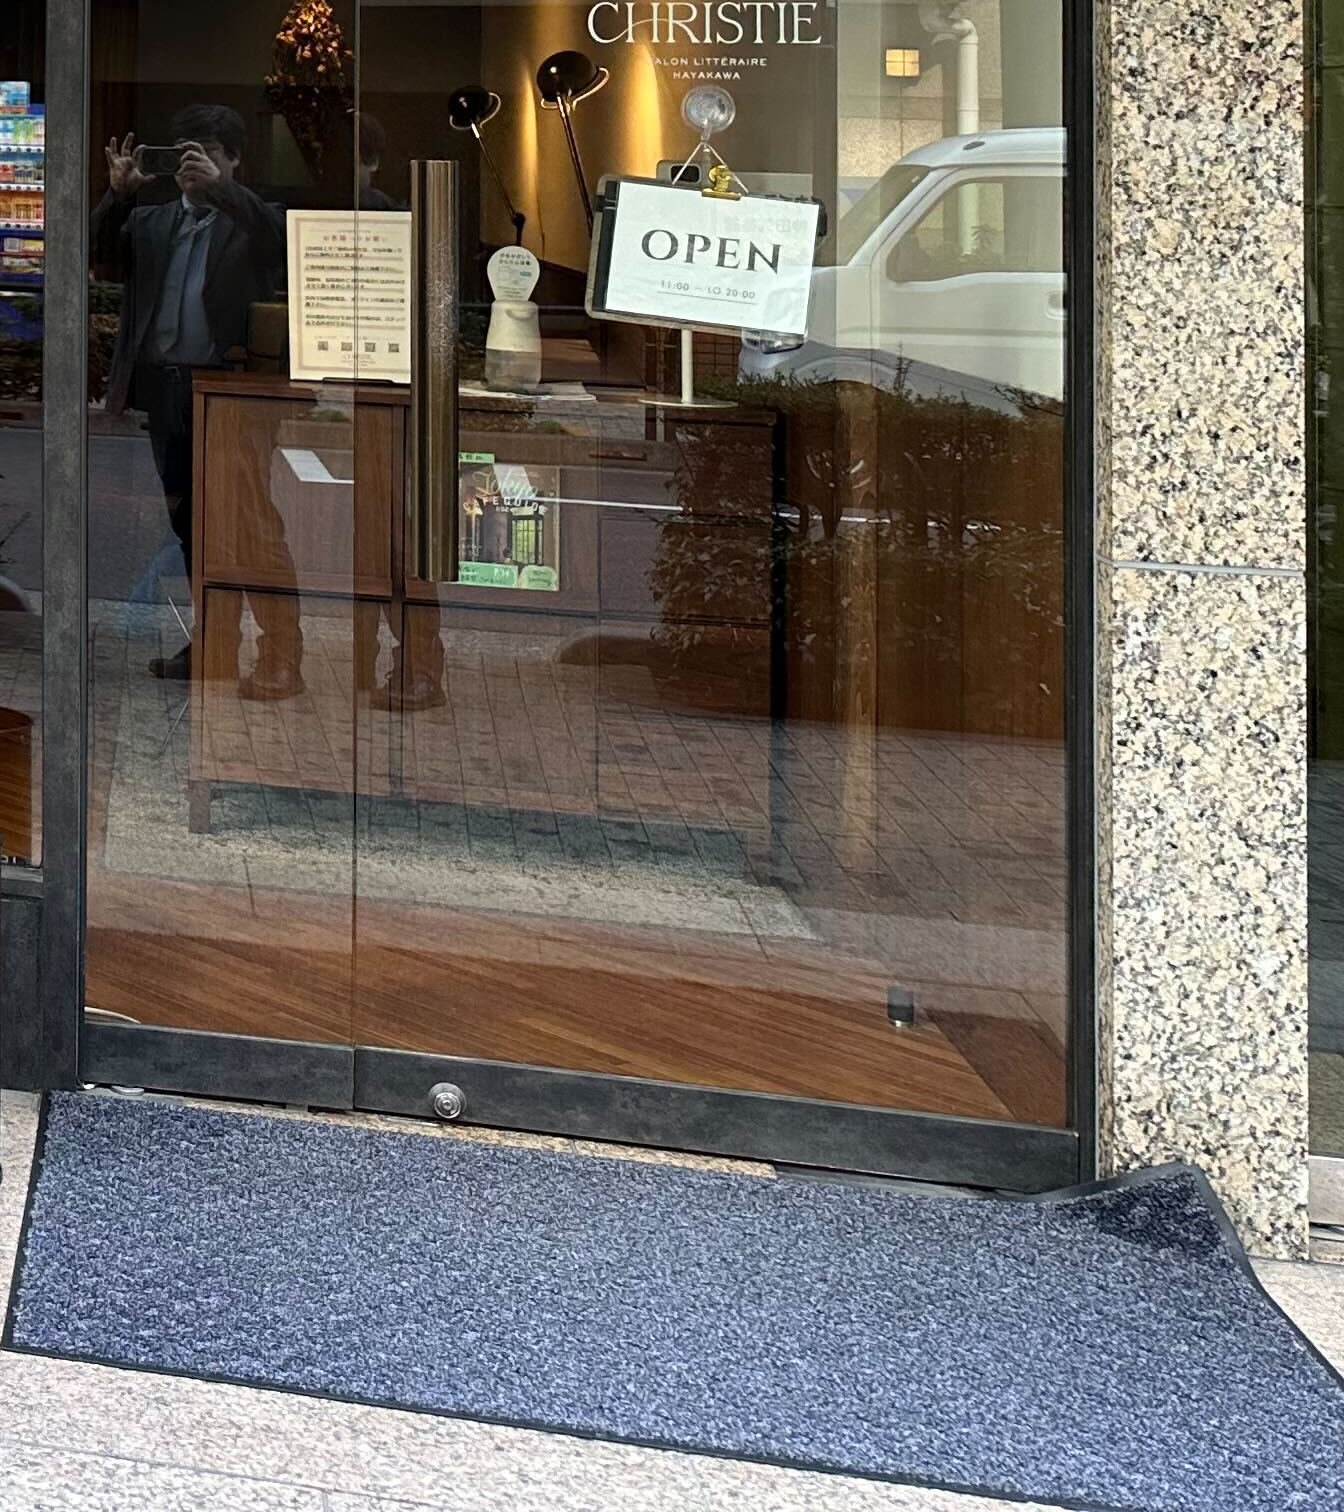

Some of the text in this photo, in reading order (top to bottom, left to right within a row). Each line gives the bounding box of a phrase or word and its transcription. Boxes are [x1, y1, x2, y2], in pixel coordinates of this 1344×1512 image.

[587, 1, 822, 44] CHRISTIE
[647, 57, 690, 67] ALON
[672, 71, 741, 80] HAYAKAWA
[641, 229, 783, 275] OPEN
